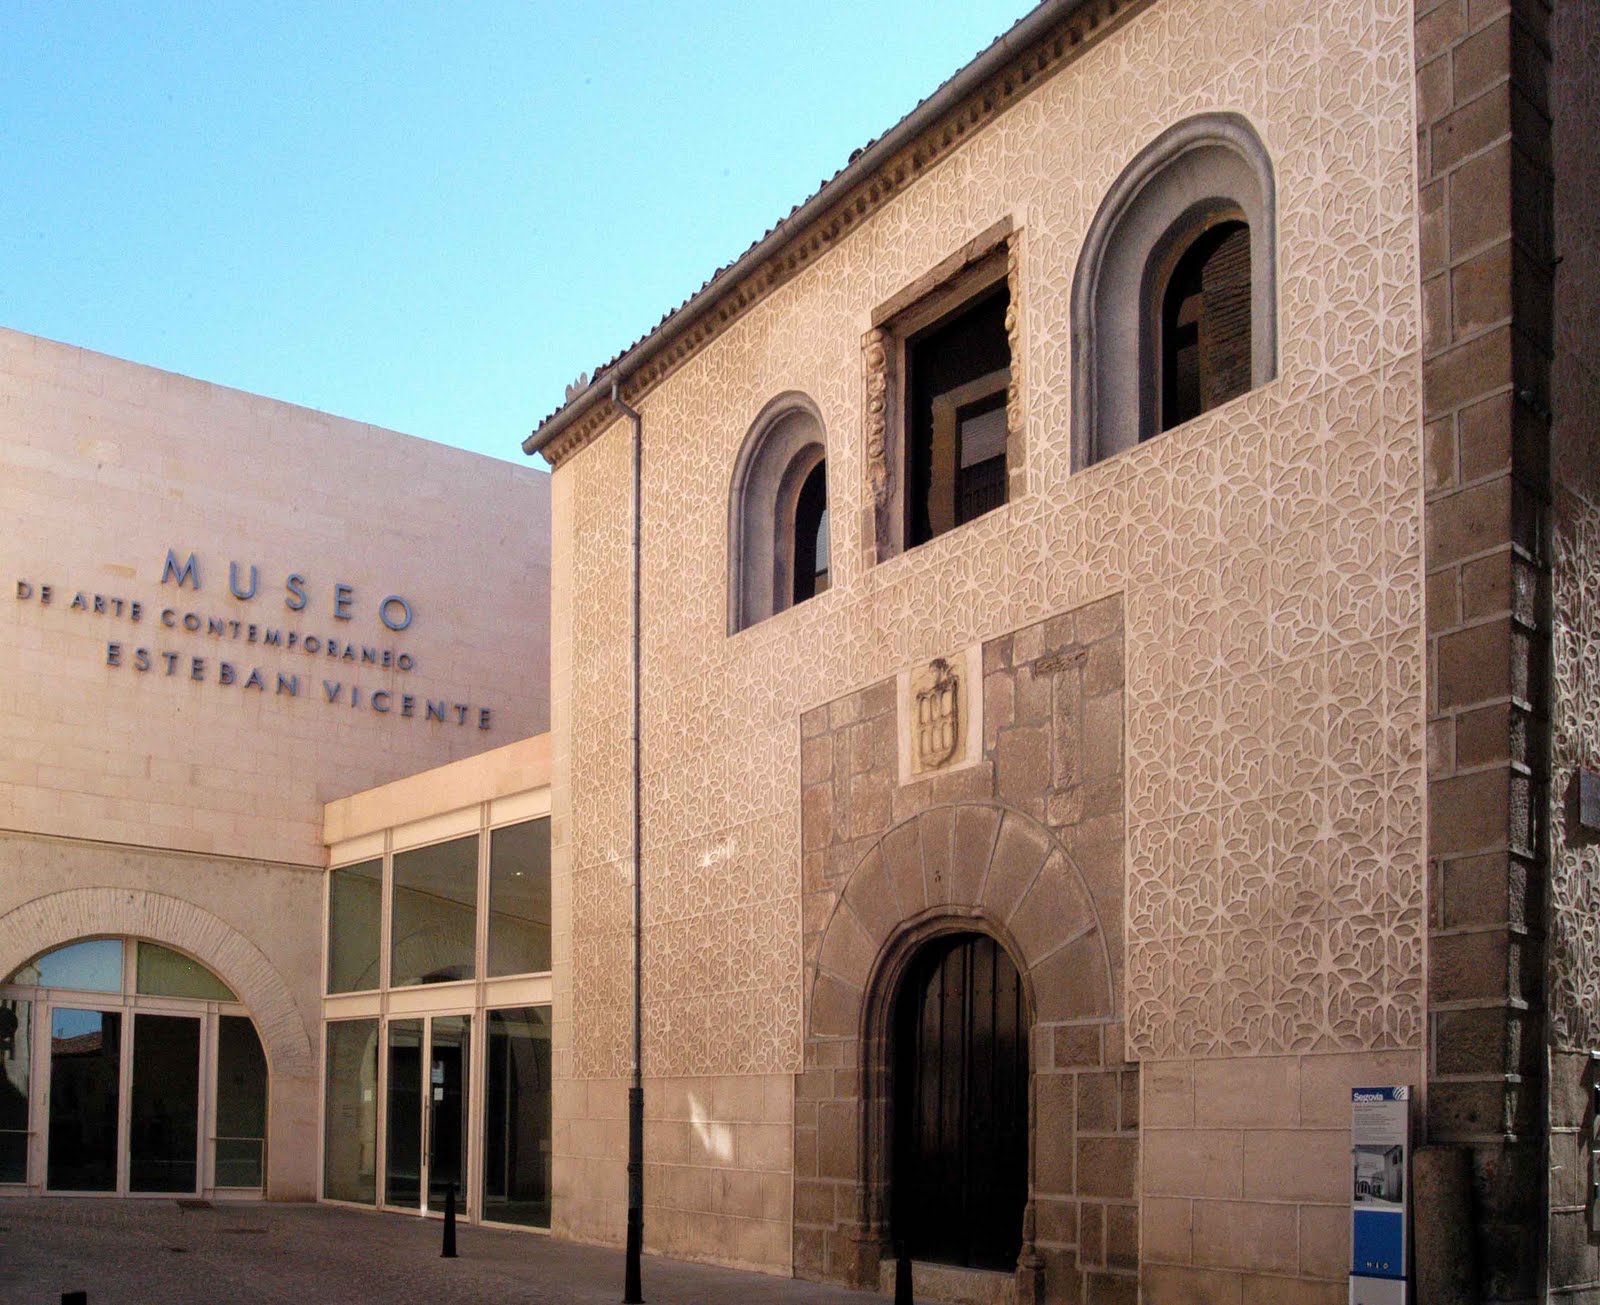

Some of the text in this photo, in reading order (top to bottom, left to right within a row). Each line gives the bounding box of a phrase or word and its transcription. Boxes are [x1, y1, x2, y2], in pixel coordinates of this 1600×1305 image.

[16, 579, 415, 670] DE ARTE CONTEMPORANEO
[161, 548, 413, 631] MUSEO
[106, 641, 491, 730] ESTEBAN VICENTE
[1353, 1092, 1384, 1104] Segovia
